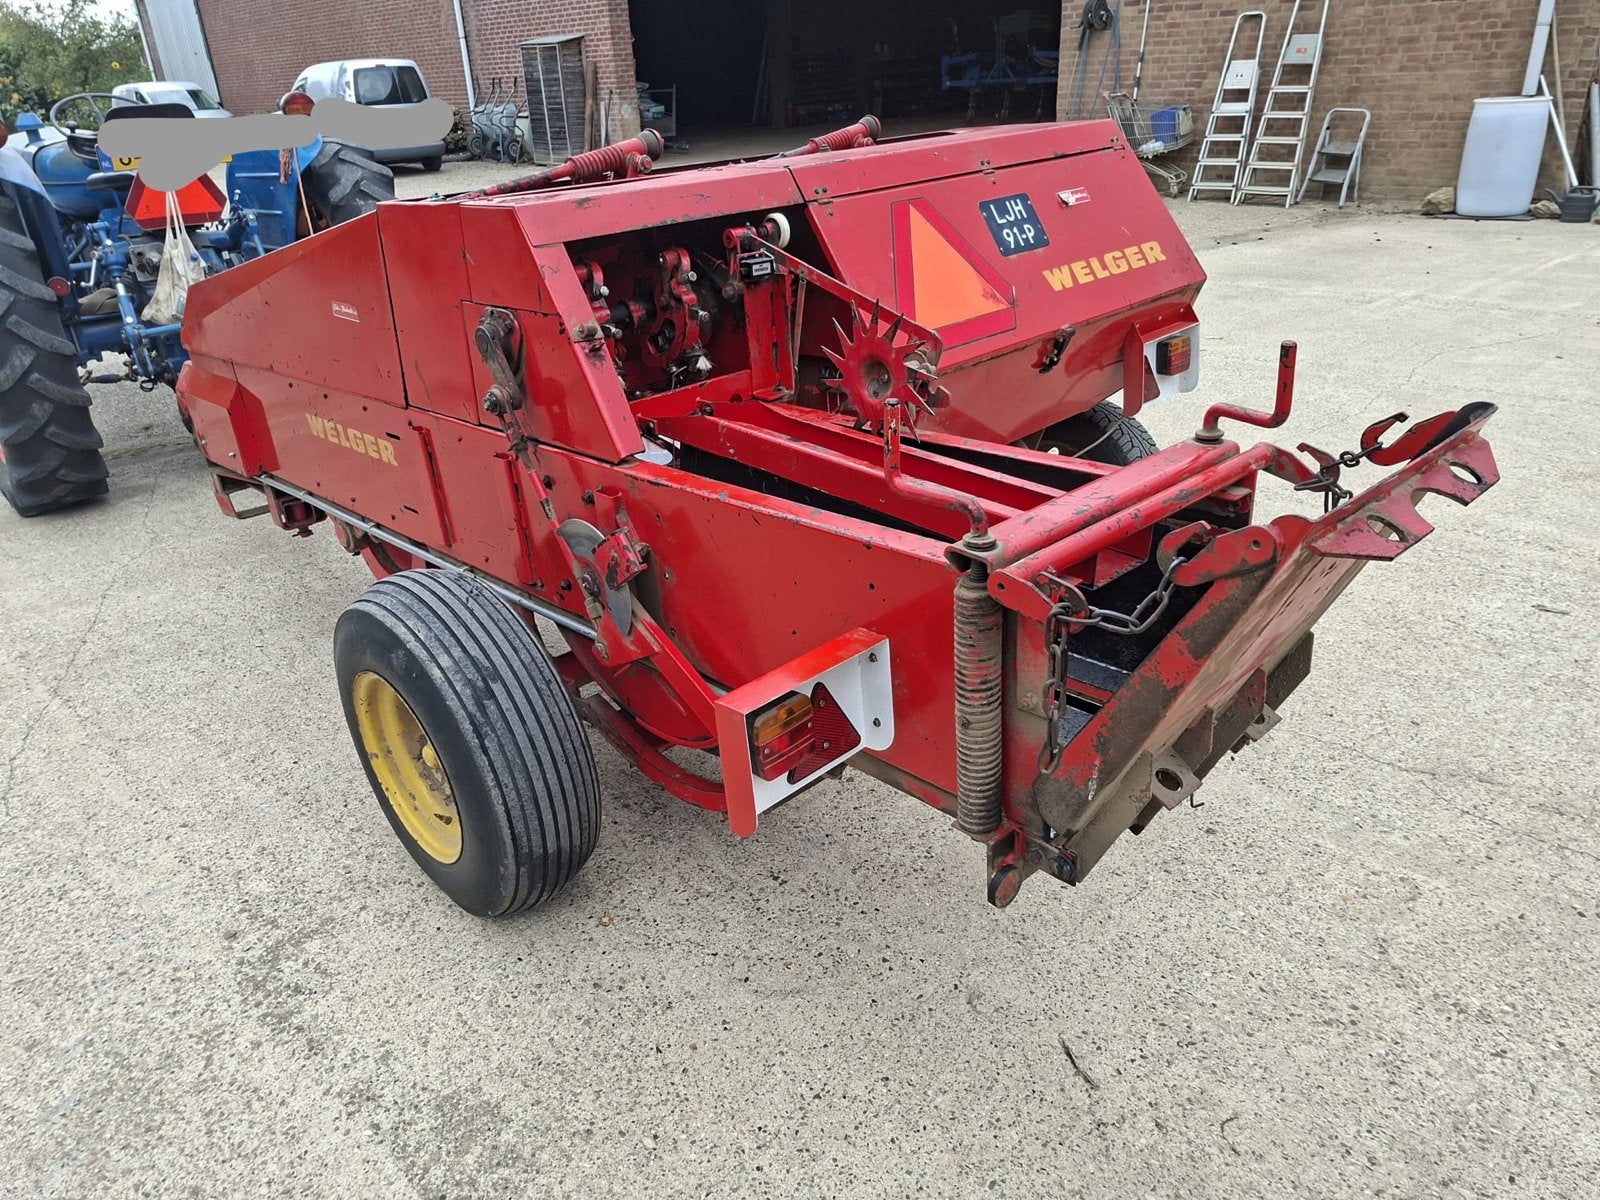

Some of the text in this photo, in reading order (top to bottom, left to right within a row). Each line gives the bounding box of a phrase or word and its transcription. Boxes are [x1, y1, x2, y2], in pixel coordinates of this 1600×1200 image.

[990, 198, 1027, 224] LJH
[1002, 224, 1035, 249] 91-P
[1042, 240, 1167, 292] WELGER
[305, 412, 399, 467] WELGER
